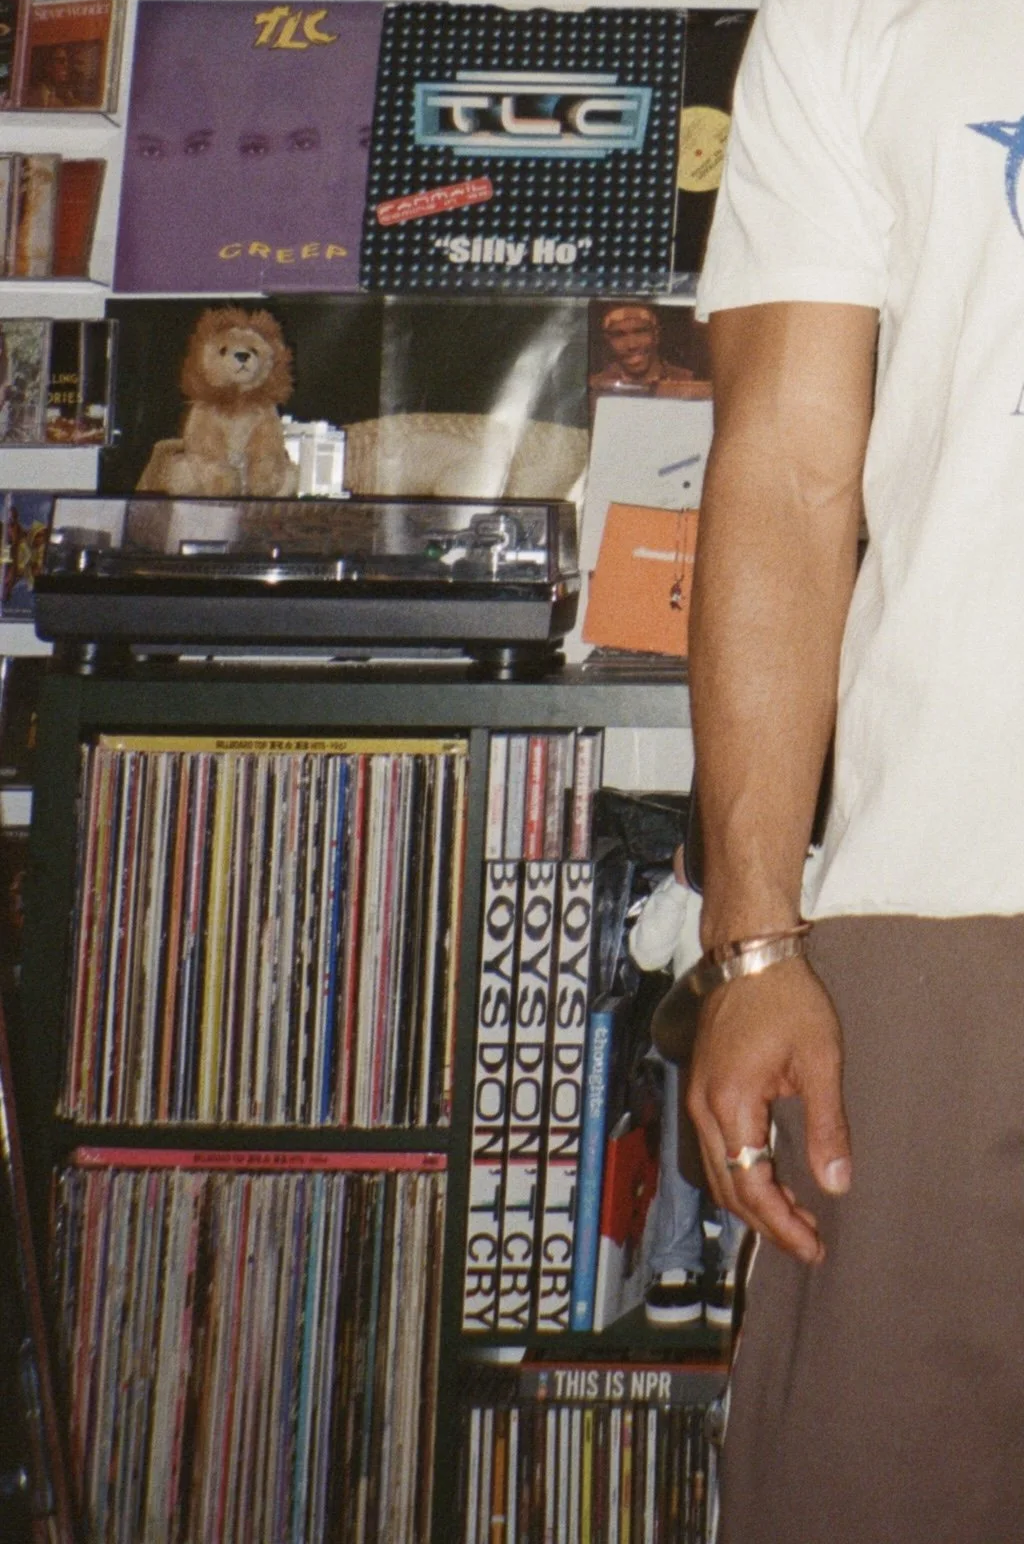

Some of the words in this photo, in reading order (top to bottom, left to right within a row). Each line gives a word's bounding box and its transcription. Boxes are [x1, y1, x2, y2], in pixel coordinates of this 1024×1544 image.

[252, 5, 338, 50] TLC
[426, 94, 640, 137] TLC
[218, 241, 348, 264] CREEP
[481, 862, 518, 1029] BOYS
[518, 862, 555, 1029] BOYS
[556, 862, 594, 1030] BOYS
[588, 1026, 610, 1118] thoughts
[470, 1042, 509, 1222] DON'T
[506, 1042, 545, 1222] DON'T
[545, 1042, 584, 1223] DON'T
[465, 1232, 498, 1329] CRY
[499, 1232, 533, 1329] CRY
[539, 1232, 573, 1330] CRY
[554, 1369, 599, 1399] THIS
[605, 1370, 624, 1398] IS
[630, 1370, 672, 1400] NPR
